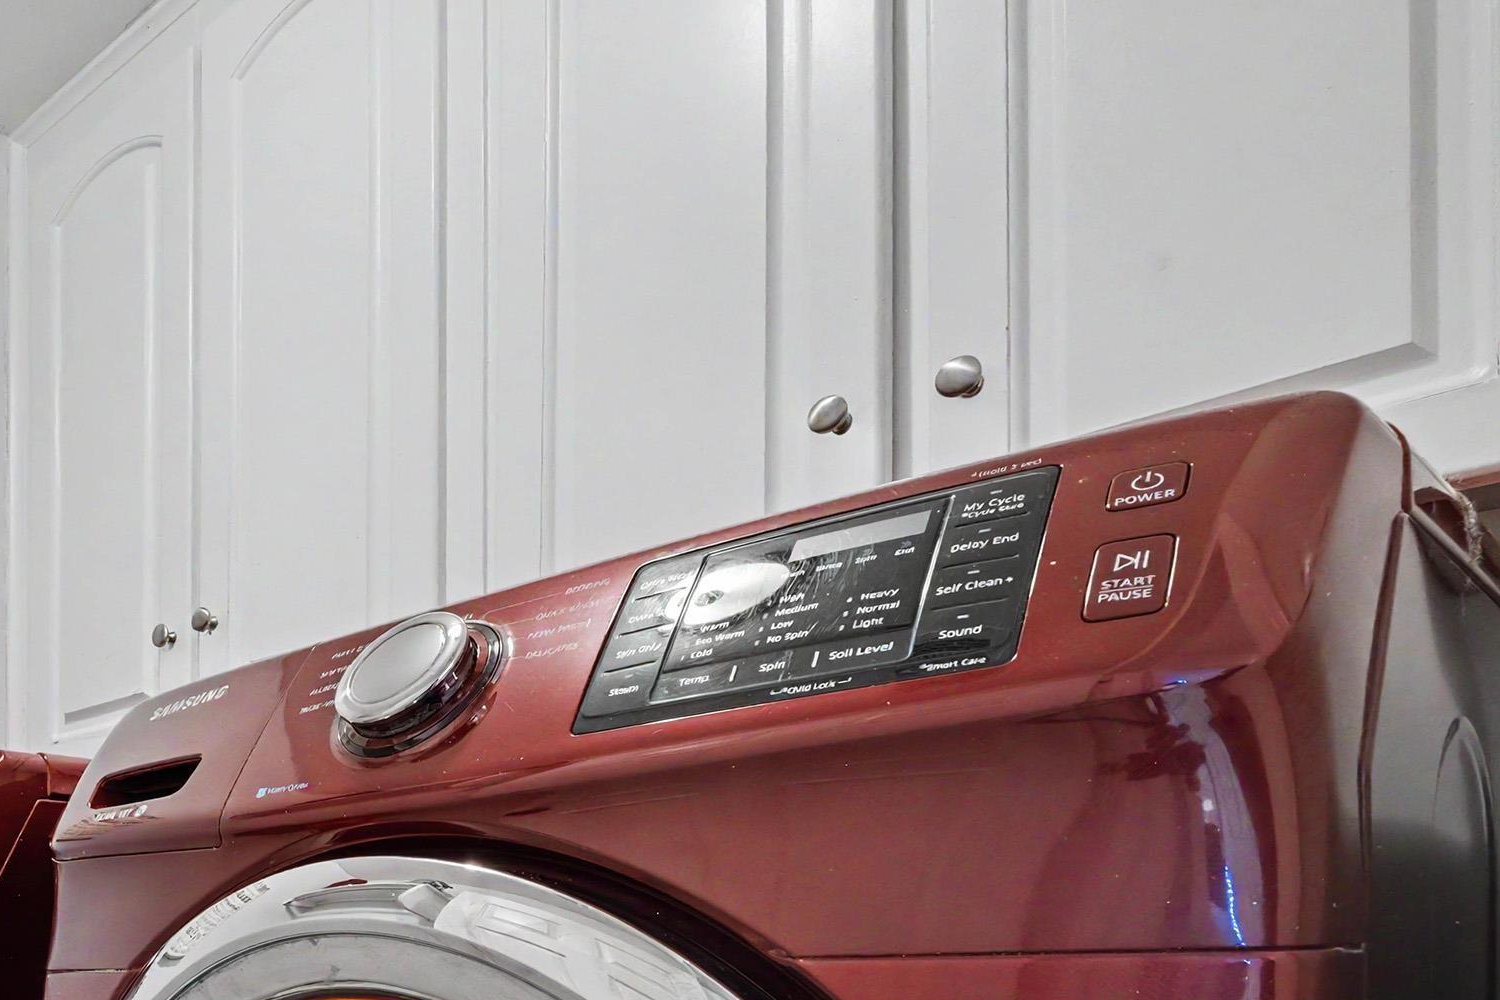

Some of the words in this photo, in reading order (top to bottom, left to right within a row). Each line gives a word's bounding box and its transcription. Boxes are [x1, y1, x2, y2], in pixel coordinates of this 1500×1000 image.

[964, 502, 984, 512] My
[988, 494, 1025, 507] Cycle
[1114, 489, 1175, 506] POWER
[950, 538, 989, 553] Delay
[993, 532, 1020, 544] End
[936, 583, 962, 596] Self
[1101, 575, 1156, 590] START
[861, 588, 899, 600] Heavy
[1098, 588, 1152, 603] PAUSE
[775, 603, 818, 617] Medium
[857, 600, 900, 614] Normal
[770, 620, 794, 630] Low
[938, 624, 982, 640] Sound
[856, 641, 894, 656] Level
[758, 660, 786, 673] Spin
[679, 674, 710, 686] Temp
[150, 685, 230, 721] SAMSUNG
